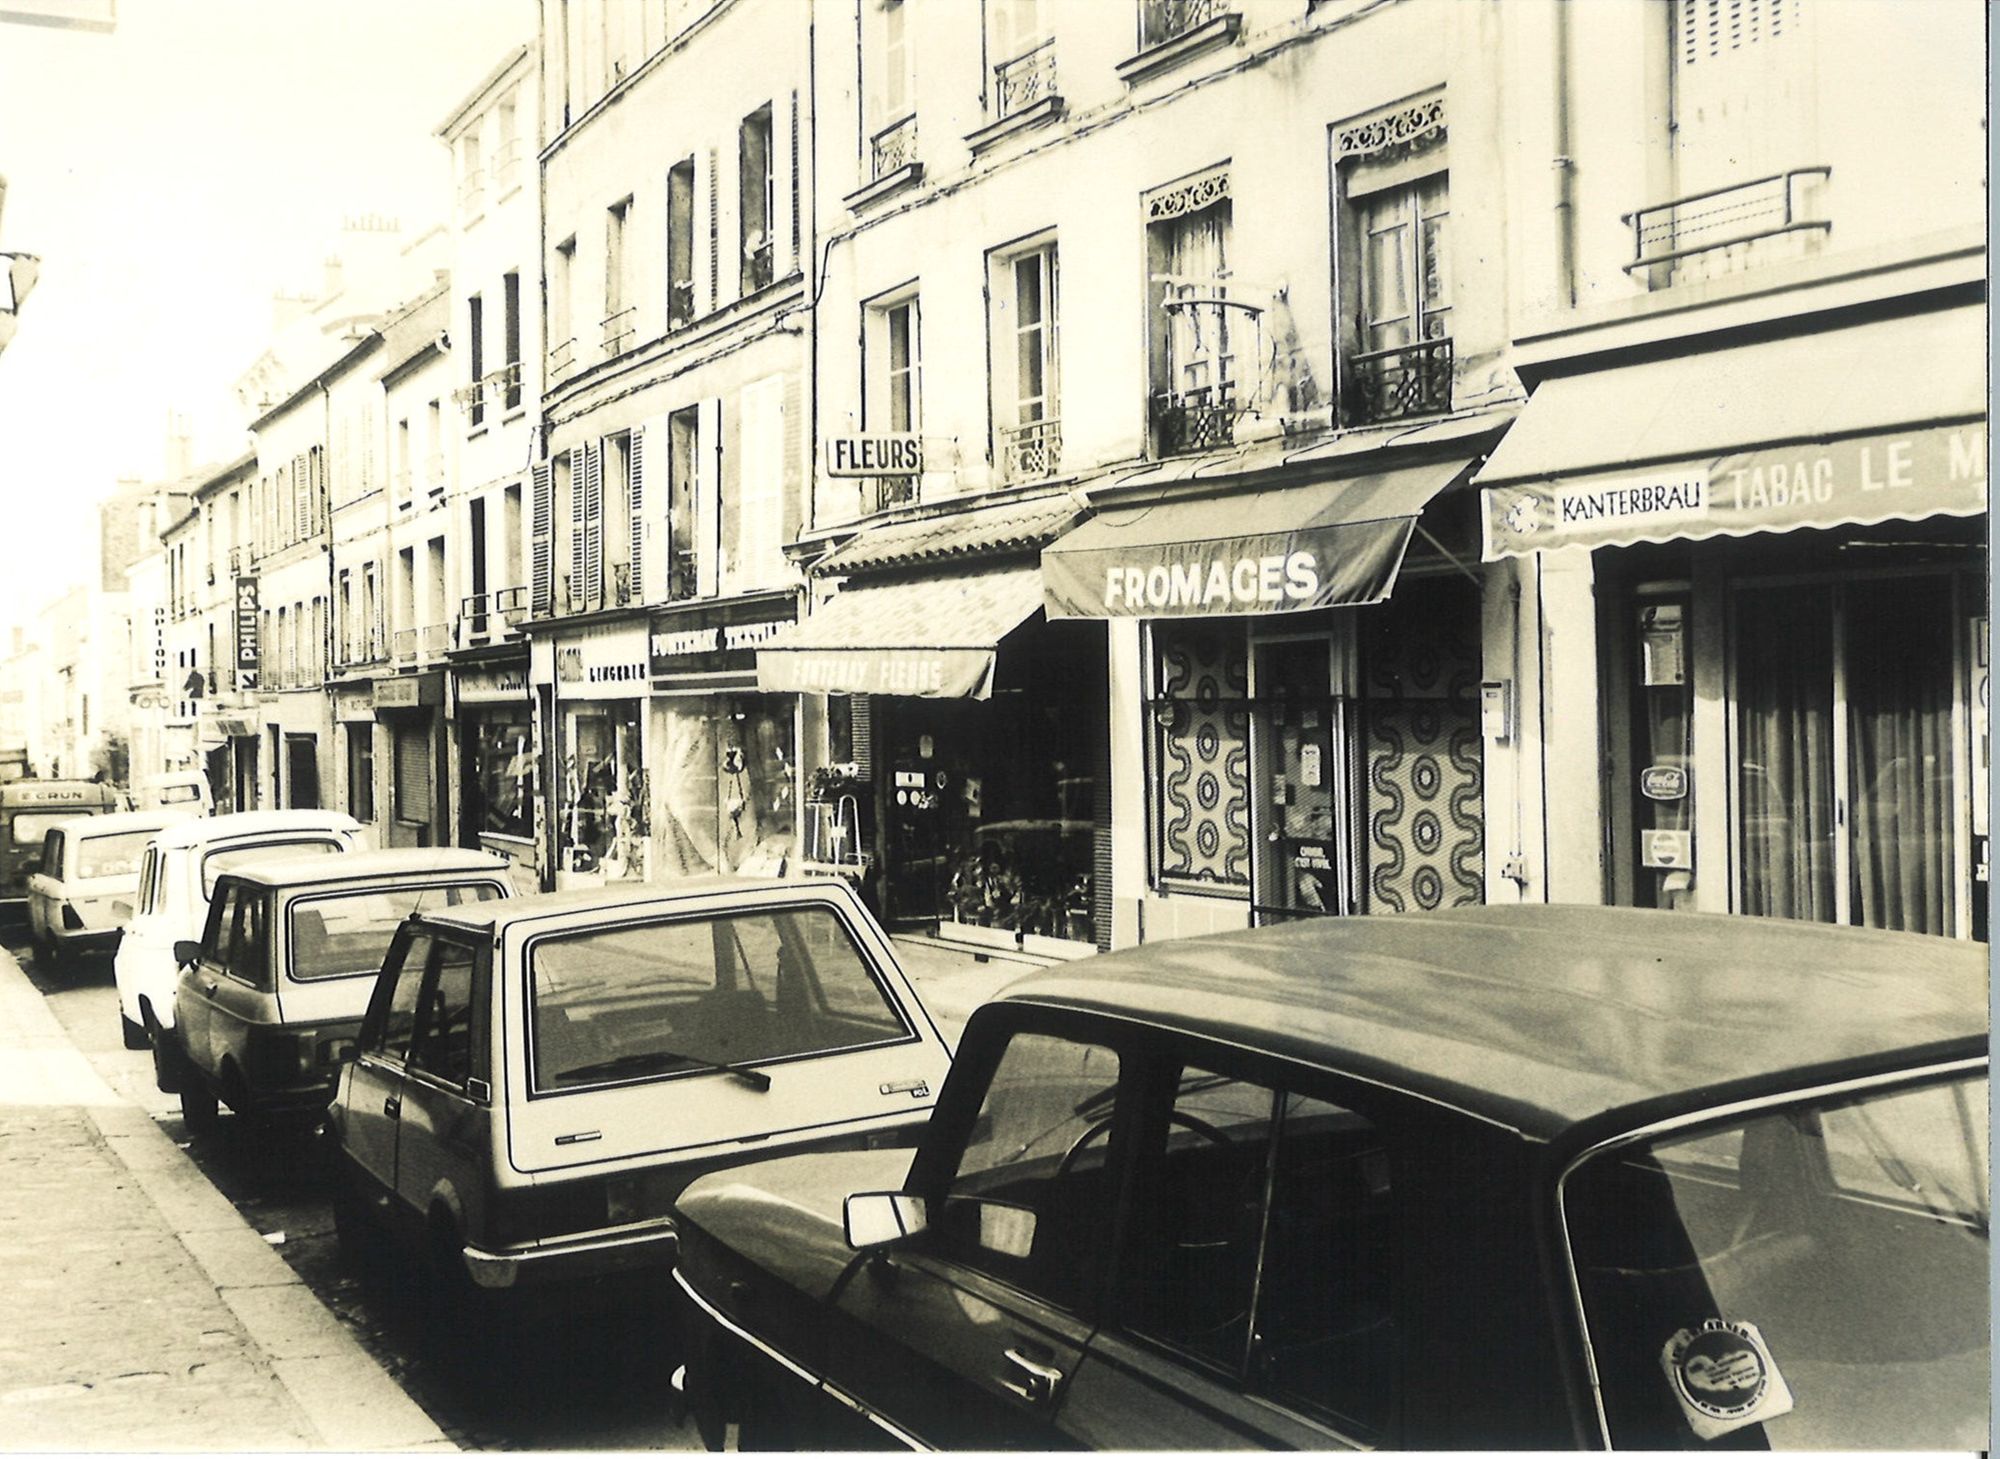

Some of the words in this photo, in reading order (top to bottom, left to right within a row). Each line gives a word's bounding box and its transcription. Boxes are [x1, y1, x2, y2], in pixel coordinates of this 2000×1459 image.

[836, 439, 918, 469] FLEURS
[1728, 458, 1834, 511] TABAC
[1860, 440, 1913, 491] LE
[1562, 482, 1700, 522] KANTERBRAU
[1104, 551, 1319, 607] FROMAGES
[239, 585, 256, 661] PHILIPS
[589, 663, 645, 682] LINGERIE
